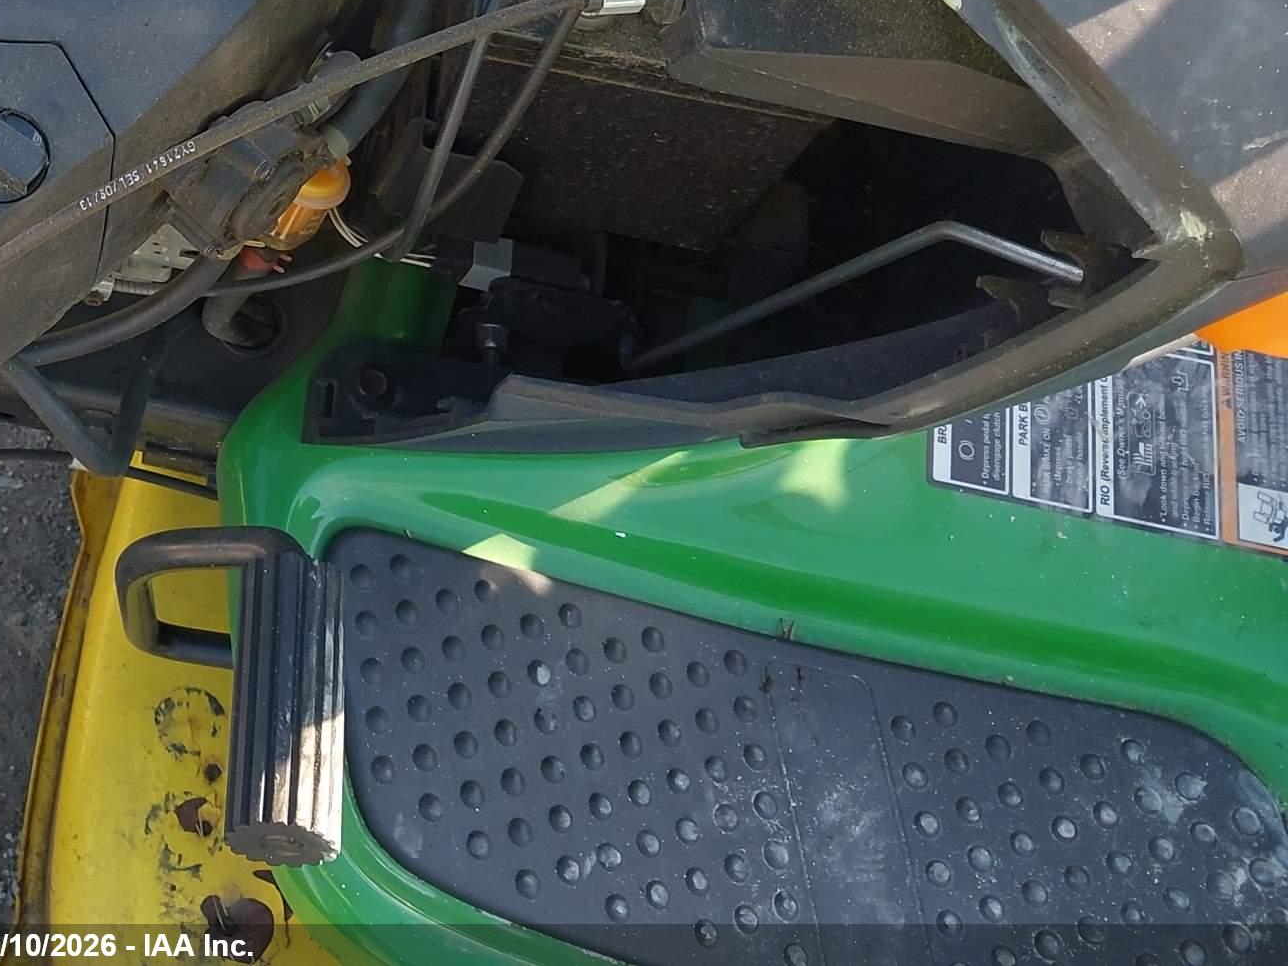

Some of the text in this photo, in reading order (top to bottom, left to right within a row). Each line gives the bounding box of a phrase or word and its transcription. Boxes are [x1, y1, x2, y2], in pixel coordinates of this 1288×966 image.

[1234, 362, 1246, 408] SERIOUS
[982, 420, 990, 443] pedal
[1017, 414, 1027, 446] PARK
[1043, 426, 1051, 440] ON
[1235, 409, 1246, 443] AVOID
[981, 445, 990, 478] Depress
[992, 438, 1001, 479] disengage
[1116, 458, 1126, 479] (See
[1158, 469, 1166, 492] down
[1098, 484, 1109, 505] RIO
[1157, 494, 1166, 516] Look
